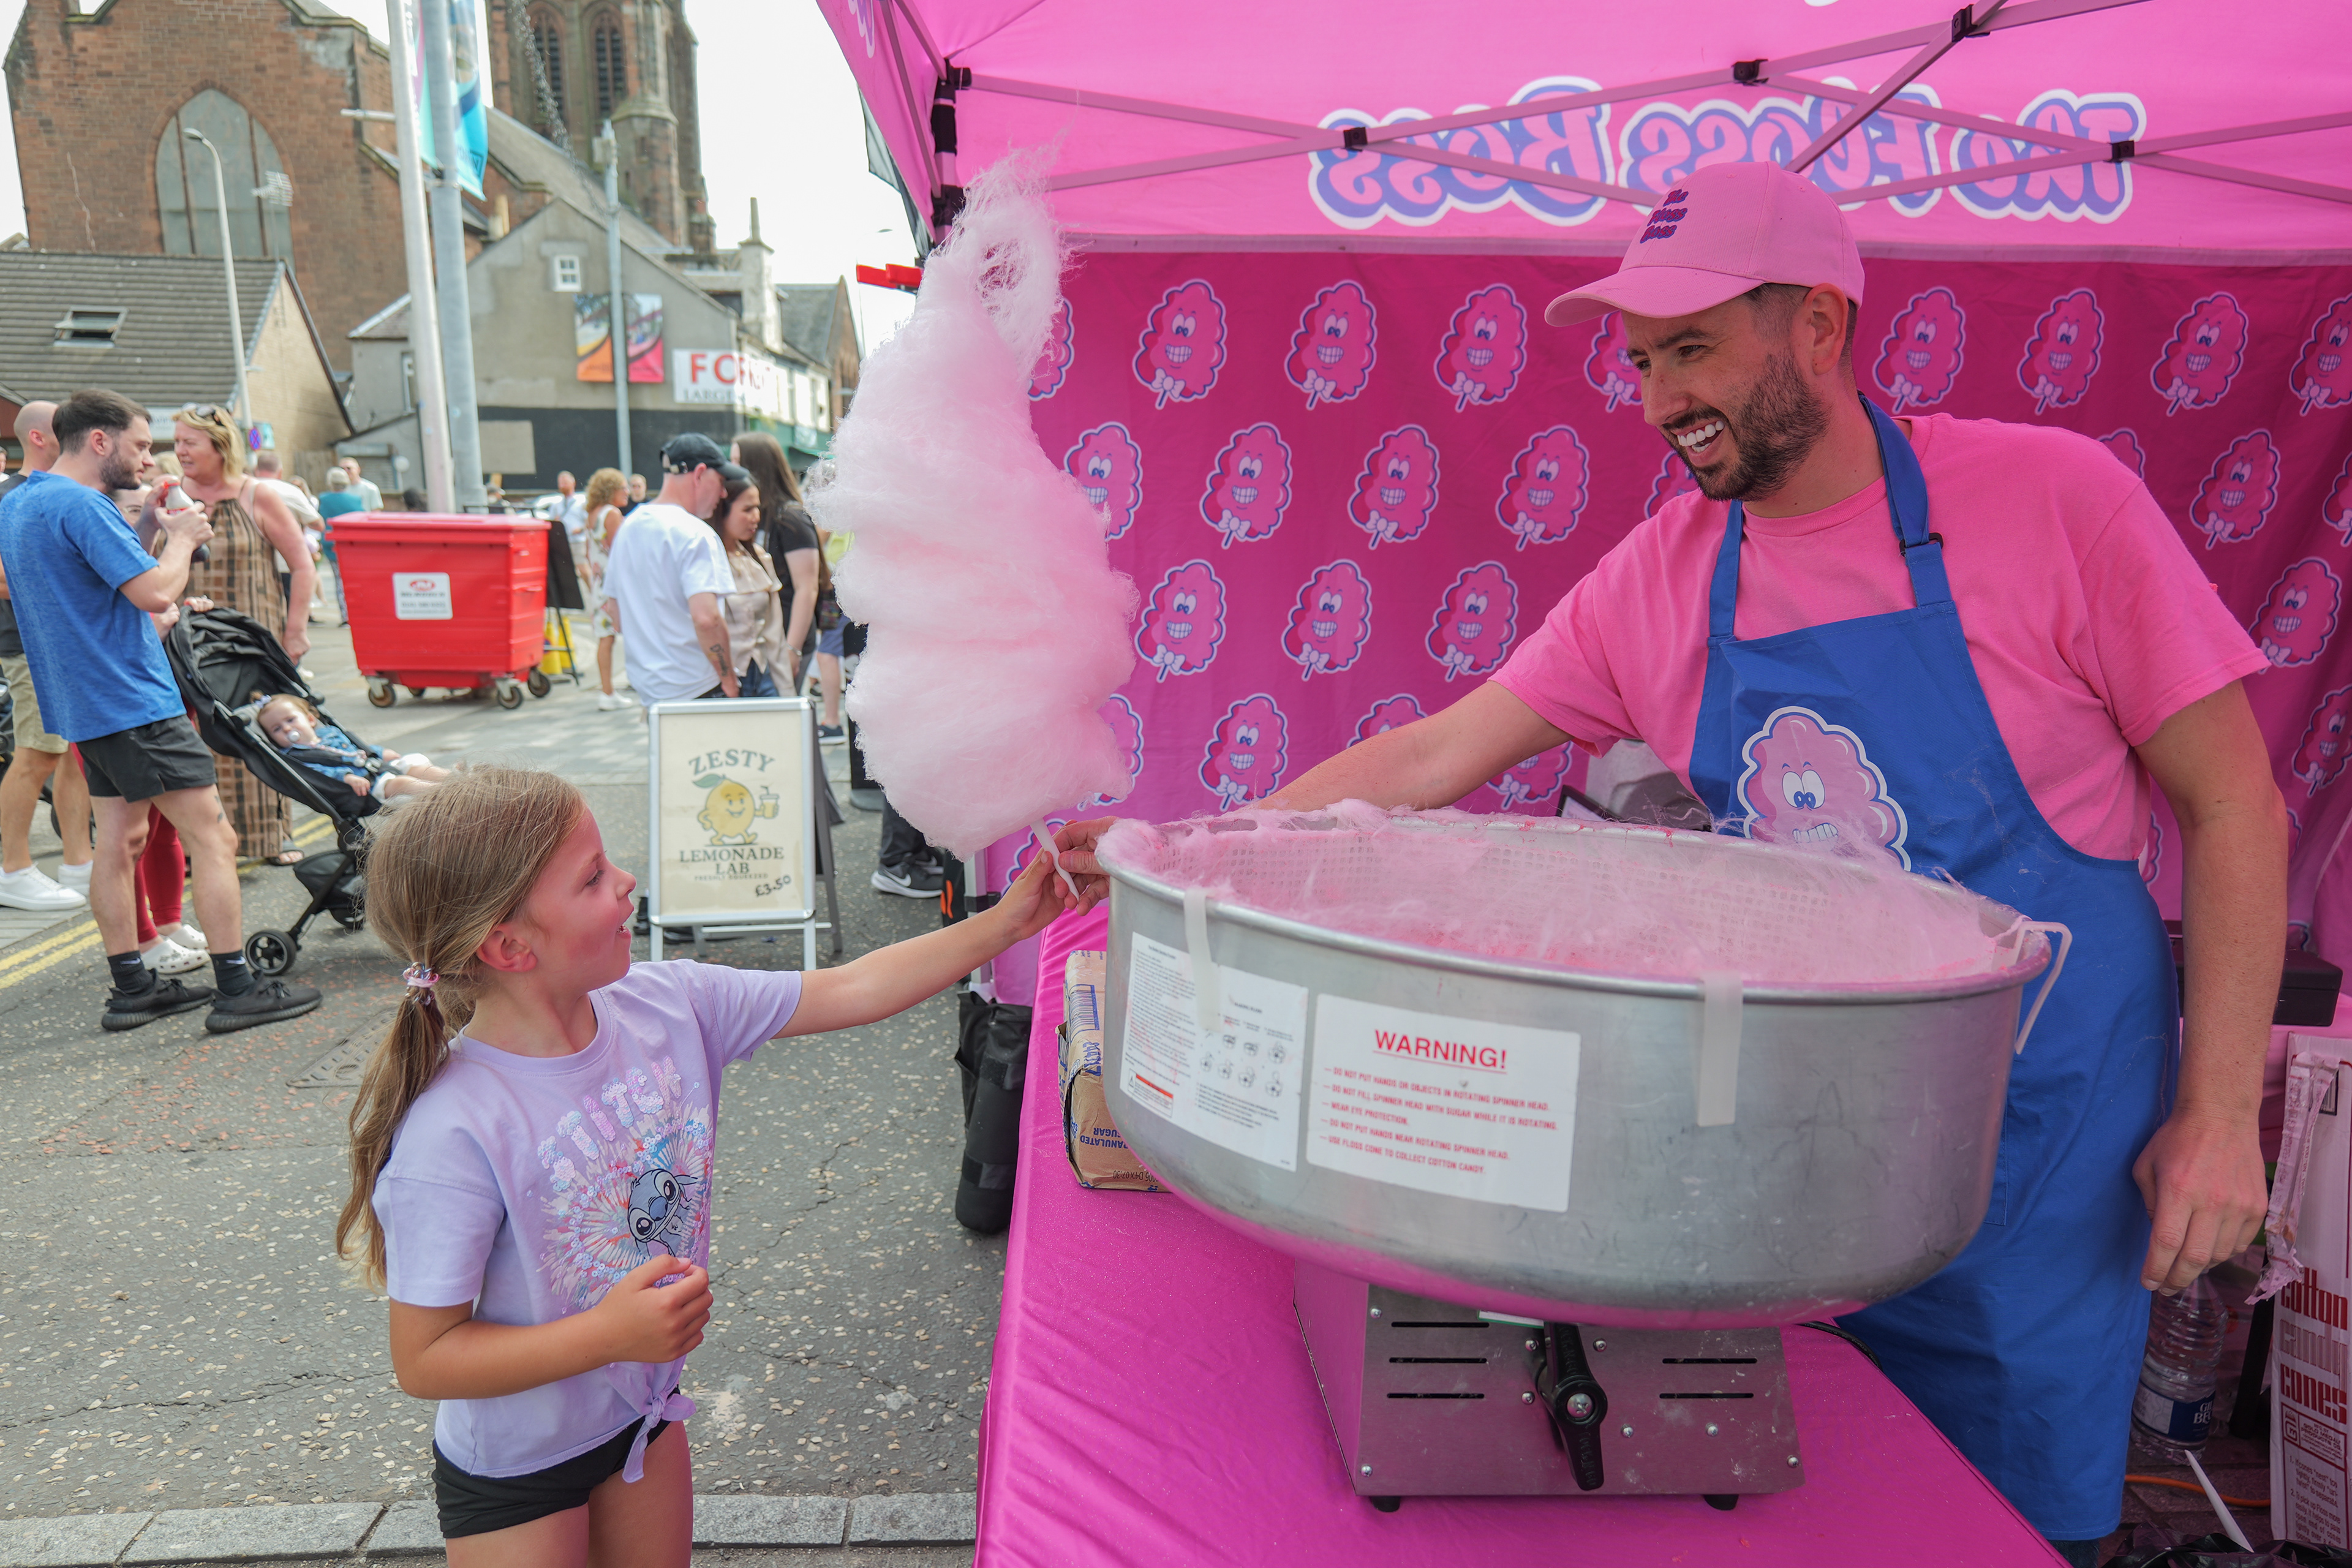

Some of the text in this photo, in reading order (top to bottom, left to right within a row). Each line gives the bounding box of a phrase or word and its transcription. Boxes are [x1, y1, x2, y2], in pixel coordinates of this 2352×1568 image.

[688, 748, 776, 776] ZESTY
[679, 847, 785, 863] LEMONADE
[715, 862, 750, 876] LAB
[754, 875, 792, 898] £3.50
[1374, 1029, 1507, 1069] WARNING!
[1333, 1066, 1343, 1076] DO
[1344, 1069, 1357, 1079] NOT
[1359, 1072, 1372, 1082] PUT
[1399, 1080, 1409, 1089] OR
[1444, 1088, 1452, 1098] IN
[1332, 1084, 1341, 1093] DO
[1343, 1087, 1356, 1096] NOT
[1499, 1115, 1507, 1124] IT
[1508, 1117, 1516, 1125] IS
[1351, 1106, 1363, 1116] EYE
[537, 1055, 682, 1192] STITCH
[1330, 1118, 1339, 1127] DO
[1340, 1121, 1354, 1131] NOT
[1355, 1124, 1368, 1134] PUT
[1079, 1134, 1129, 1150] RANULATED
[1329, 1135, 1340, 1145] USE
[1385, 1148, 1394, 1158] TO
[1145, 1172, 1158, 1182] 006
[2281, 1267, 2348, 1330] cotton
[2280, 1319, 2348, 1392] candy
[2280, 1363, 2348, 1425] cones
